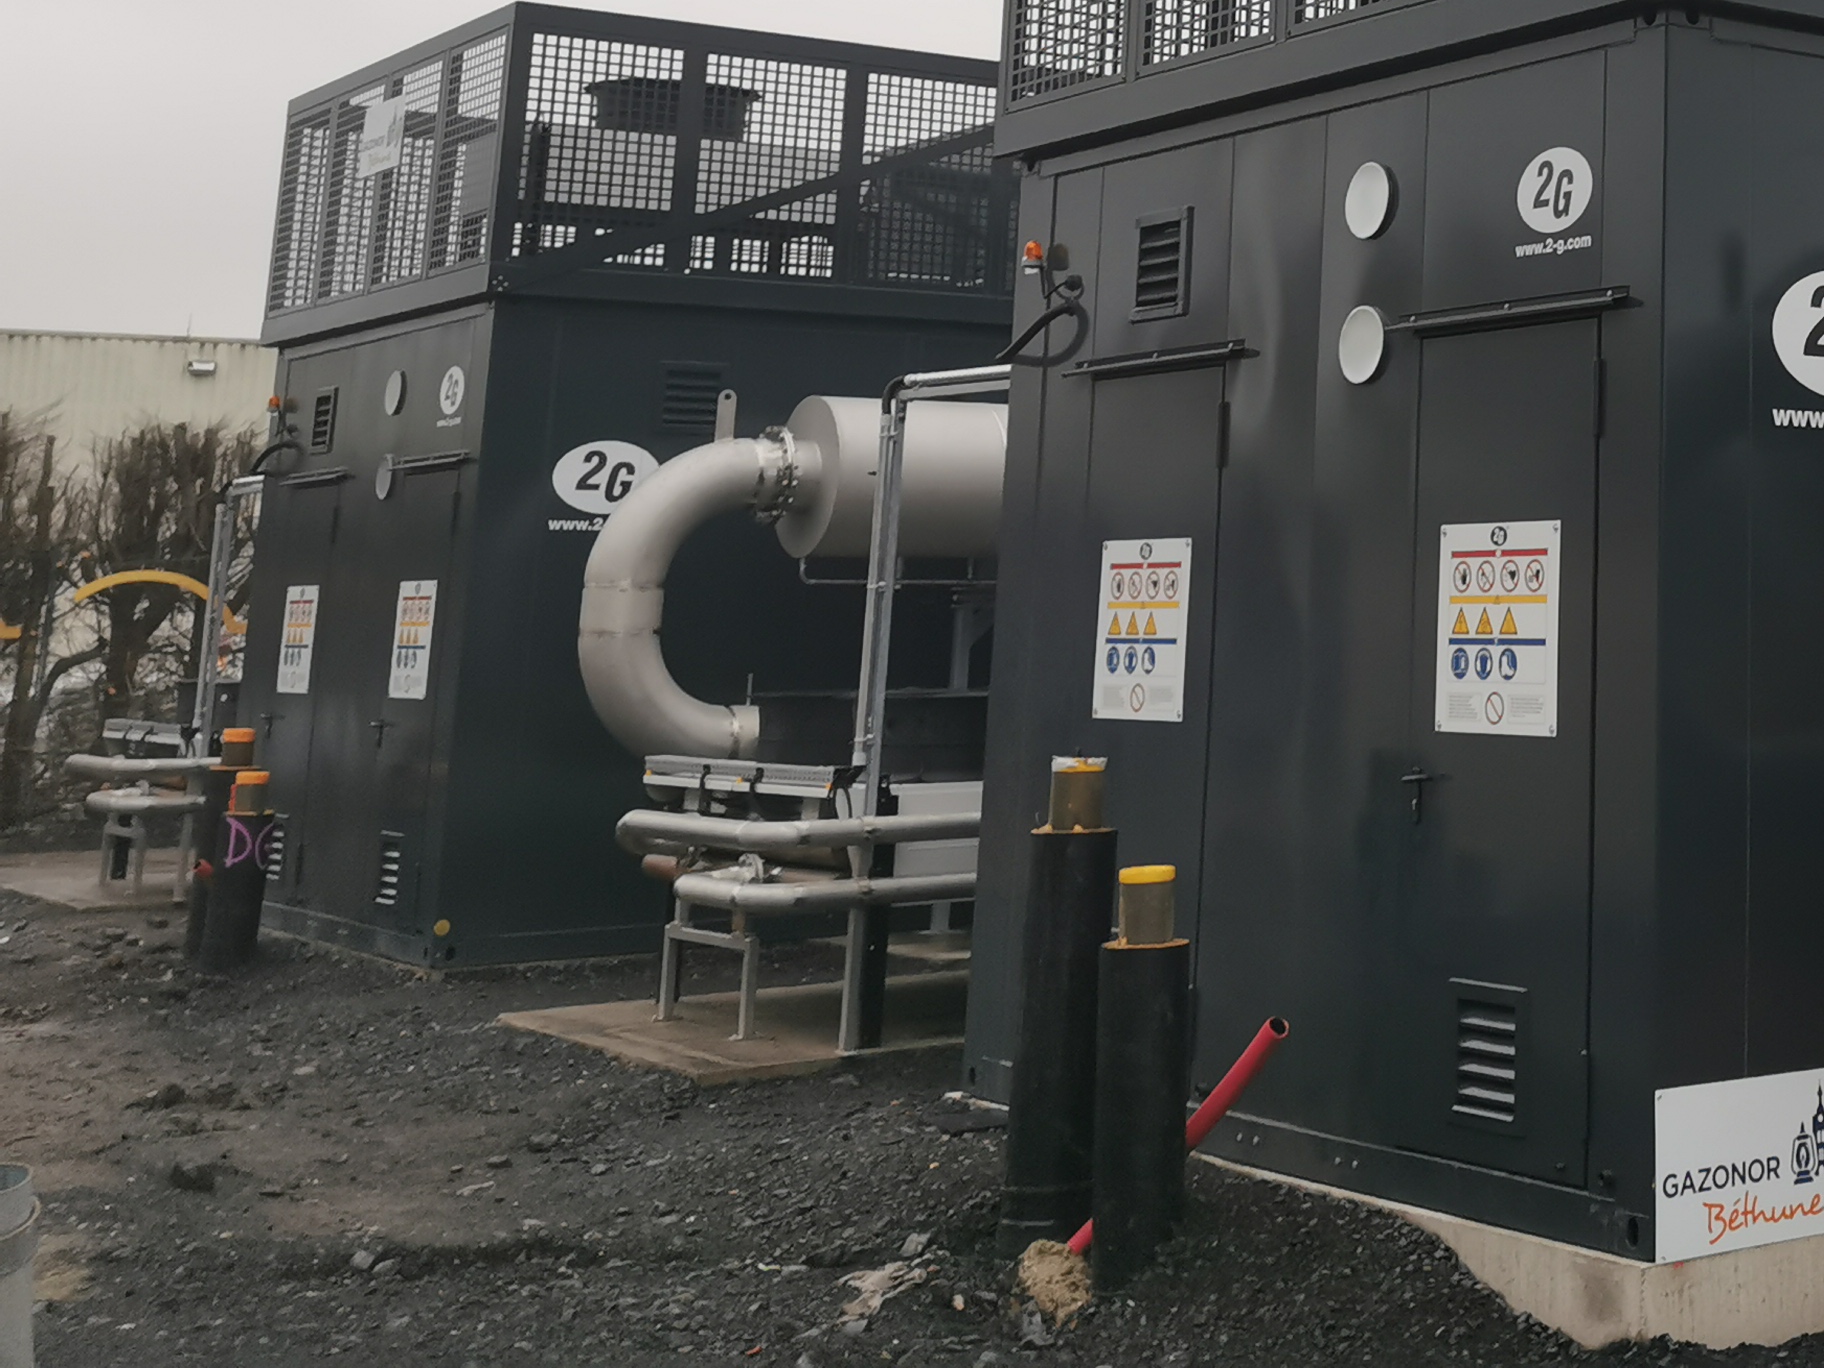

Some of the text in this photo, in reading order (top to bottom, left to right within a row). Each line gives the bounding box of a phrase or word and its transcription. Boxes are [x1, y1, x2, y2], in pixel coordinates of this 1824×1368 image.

[1533, 160, 1574, 219] 2G
[1515, 234, 1592, 258] www.2-g.com
[444, 373, 459, 407] 2G
[575, 450, 636, 503] 2G
[1662, 1156, 1781, 1198] GAZONOR
